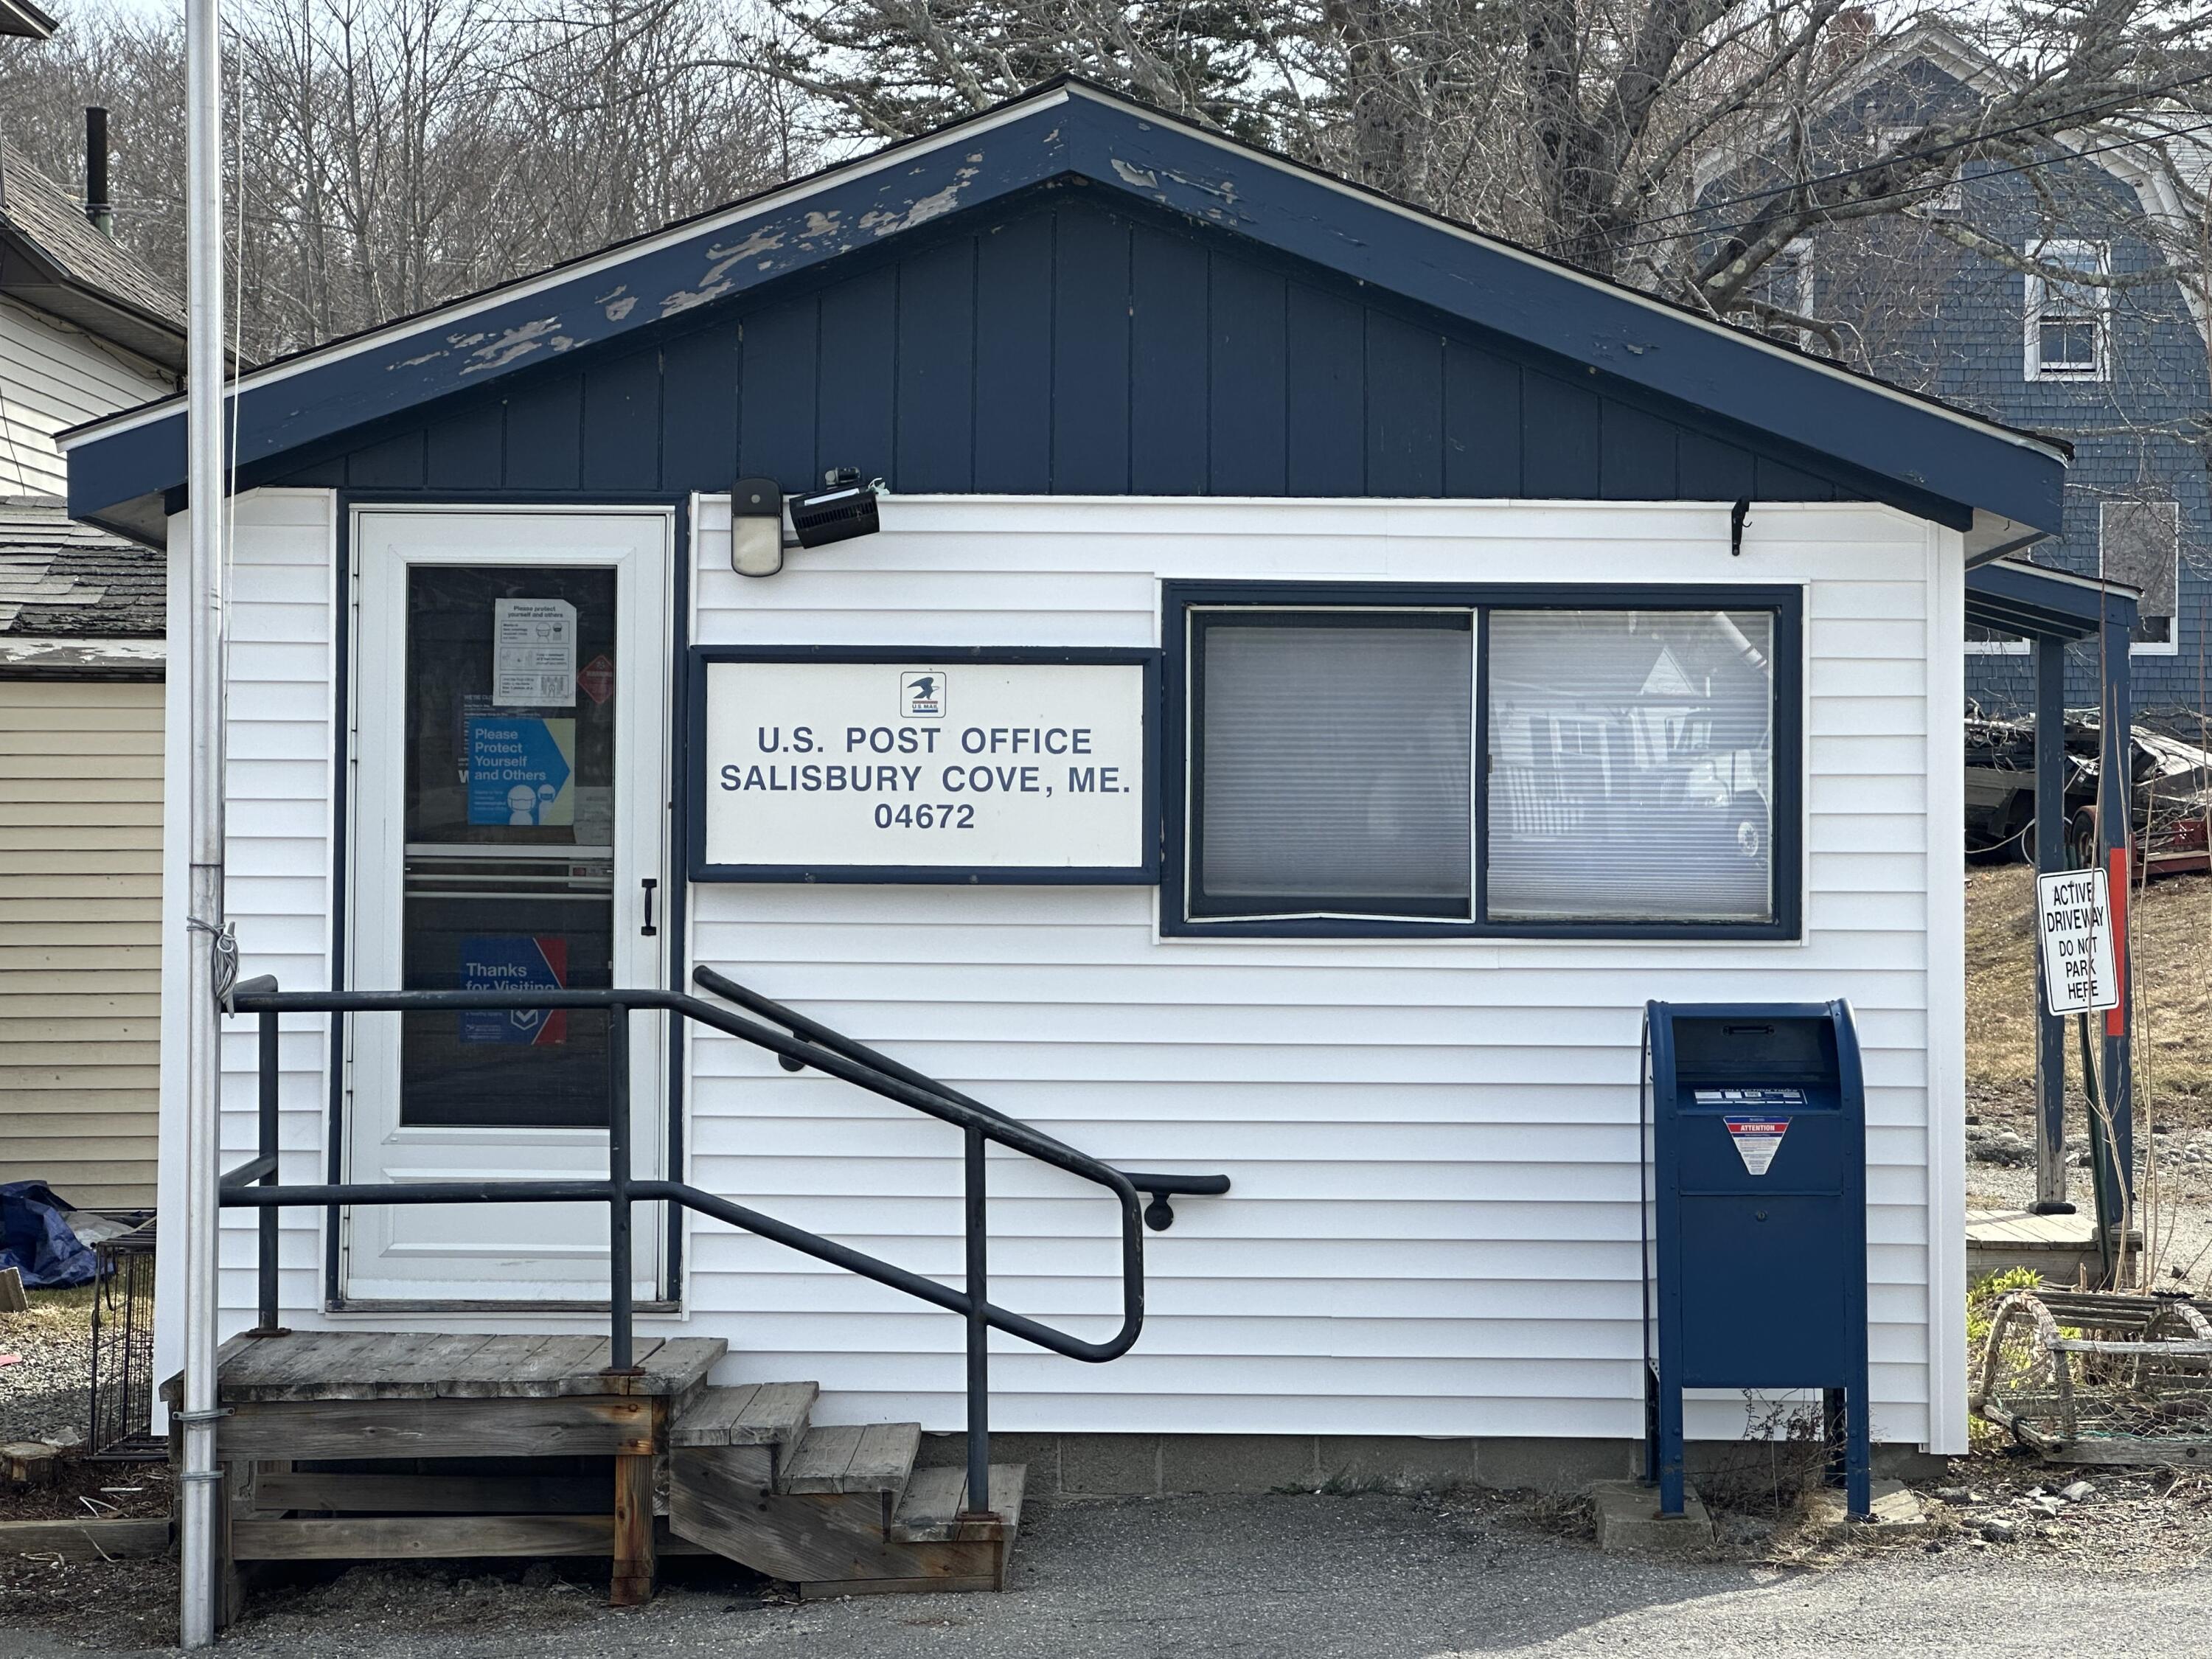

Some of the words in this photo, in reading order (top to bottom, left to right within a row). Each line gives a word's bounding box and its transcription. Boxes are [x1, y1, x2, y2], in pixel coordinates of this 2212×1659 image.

[475, 728, 518, 740] Please
[758, 727, 824, 754] U.S.
[846, 727, 941, 754] POST
[961, 728, 1093, 755] OFFICE
[475, 742, 523, 753] Protect
[474, 756, 528, 767] Yourself
[474, 770, 499, 780] and
[502, 769, 546, 780] Others
[720, 765, 922, 792] SALISBURY
[942, 766, 1054, 799] COVE,
[1068, 767, 1131, 793] ME.
[874, 804, 975, 830] 04672
[2053, 881, 2093, 906] ACTIVE
[2046, 905, 2104, 933] DRIVEWAY
[2059, 939, 2074, 957] DO
[2077, 936, 2098, 955] NOT
[466, 962, 527, 977] Thanks
[2065, 958, 2097, 978] PARK
